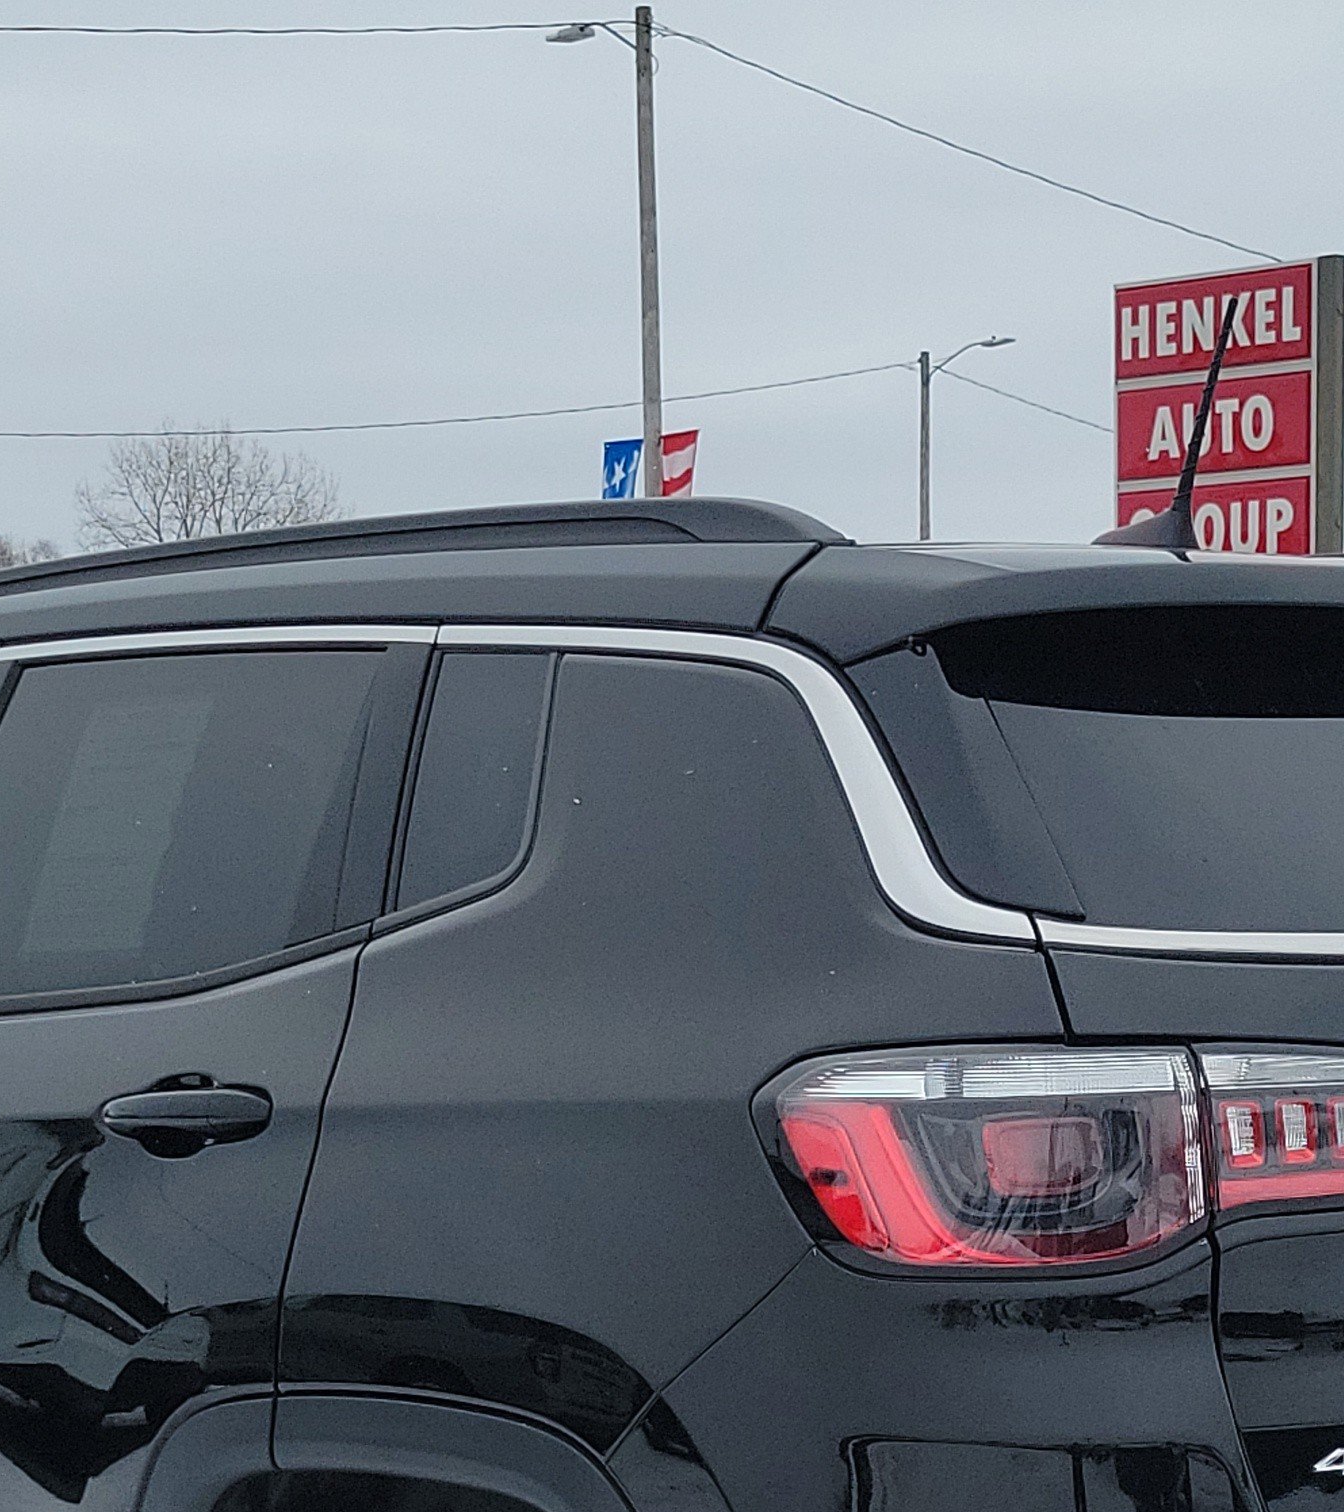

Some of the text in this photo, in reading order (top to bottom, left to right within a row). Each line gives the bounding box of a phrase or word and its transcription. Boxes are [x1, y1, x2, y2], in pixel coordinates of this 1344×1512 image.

[1121, 286, 1302, 361] HENKEL
[1147, 394, 1275, 461] AUTO
[1129, 498, 1294, 554] OUP
